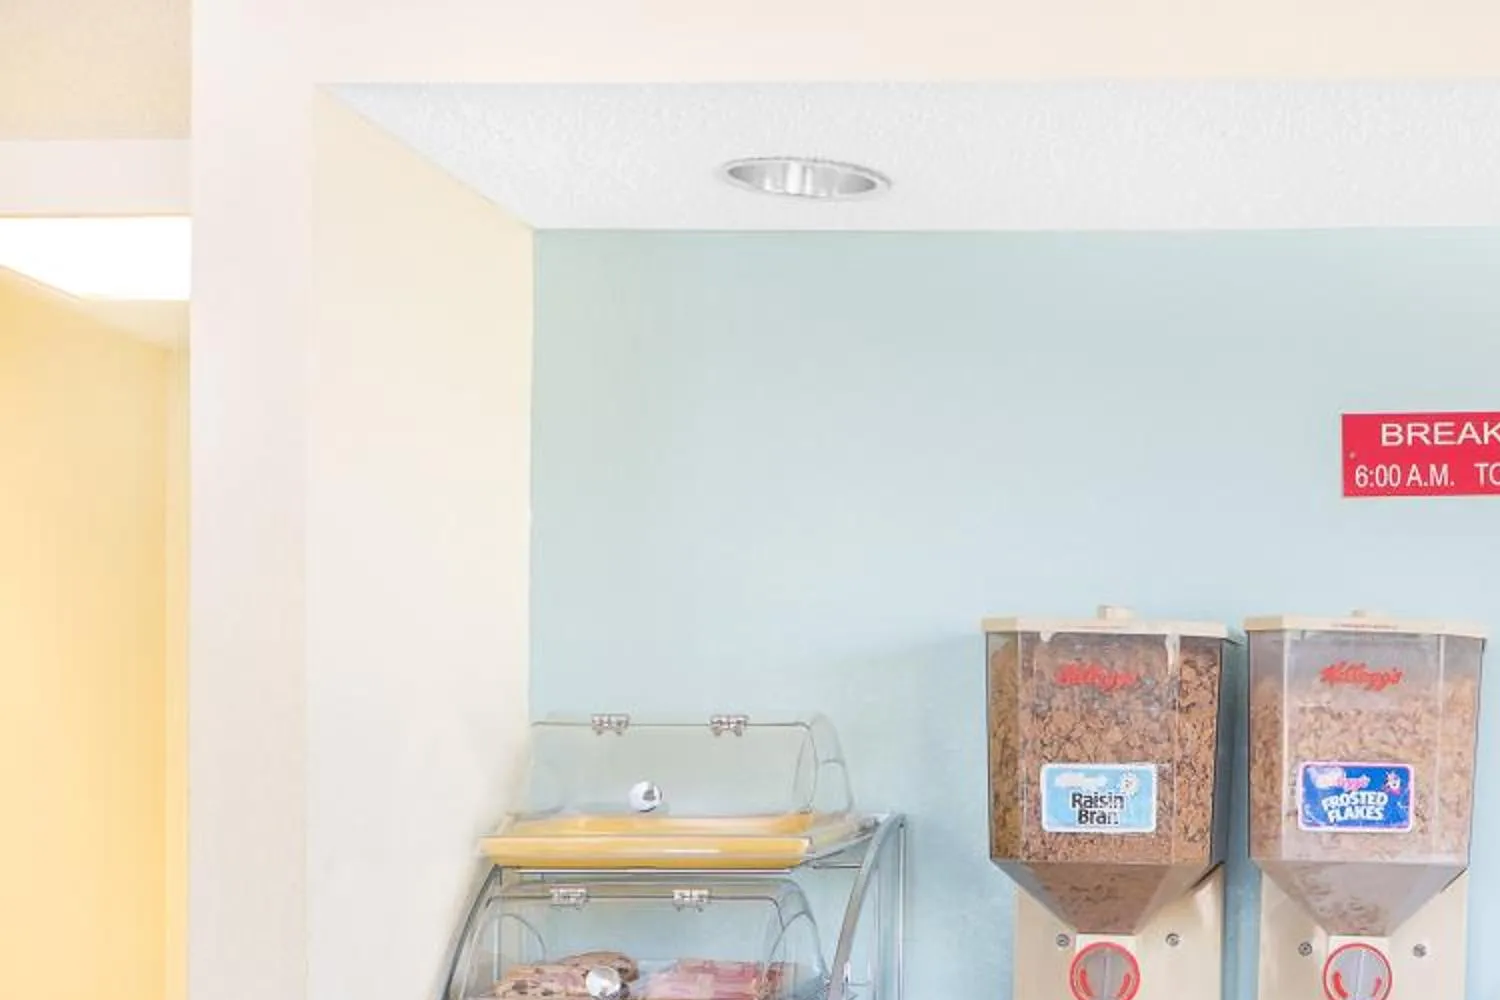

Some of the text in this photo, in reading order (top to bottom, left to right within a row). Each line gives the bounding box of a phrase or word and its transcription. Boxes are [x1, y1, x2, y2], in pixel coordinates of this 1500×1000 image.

[1355, 464, 1400, 488] 6:00
[1406, 463, 1454, 487] A.M.
[1055, 663, 1138, 692] Kellogg's
[1320, 661, 1403, 690] Kellogg's
[1071, 791, 1125, 809] Raisin
[1321, 791, 1388, 811] FROSTED
[1077, 808, 1119, 824] Bran
[1327, 804, 1385, 823] FLAKES
